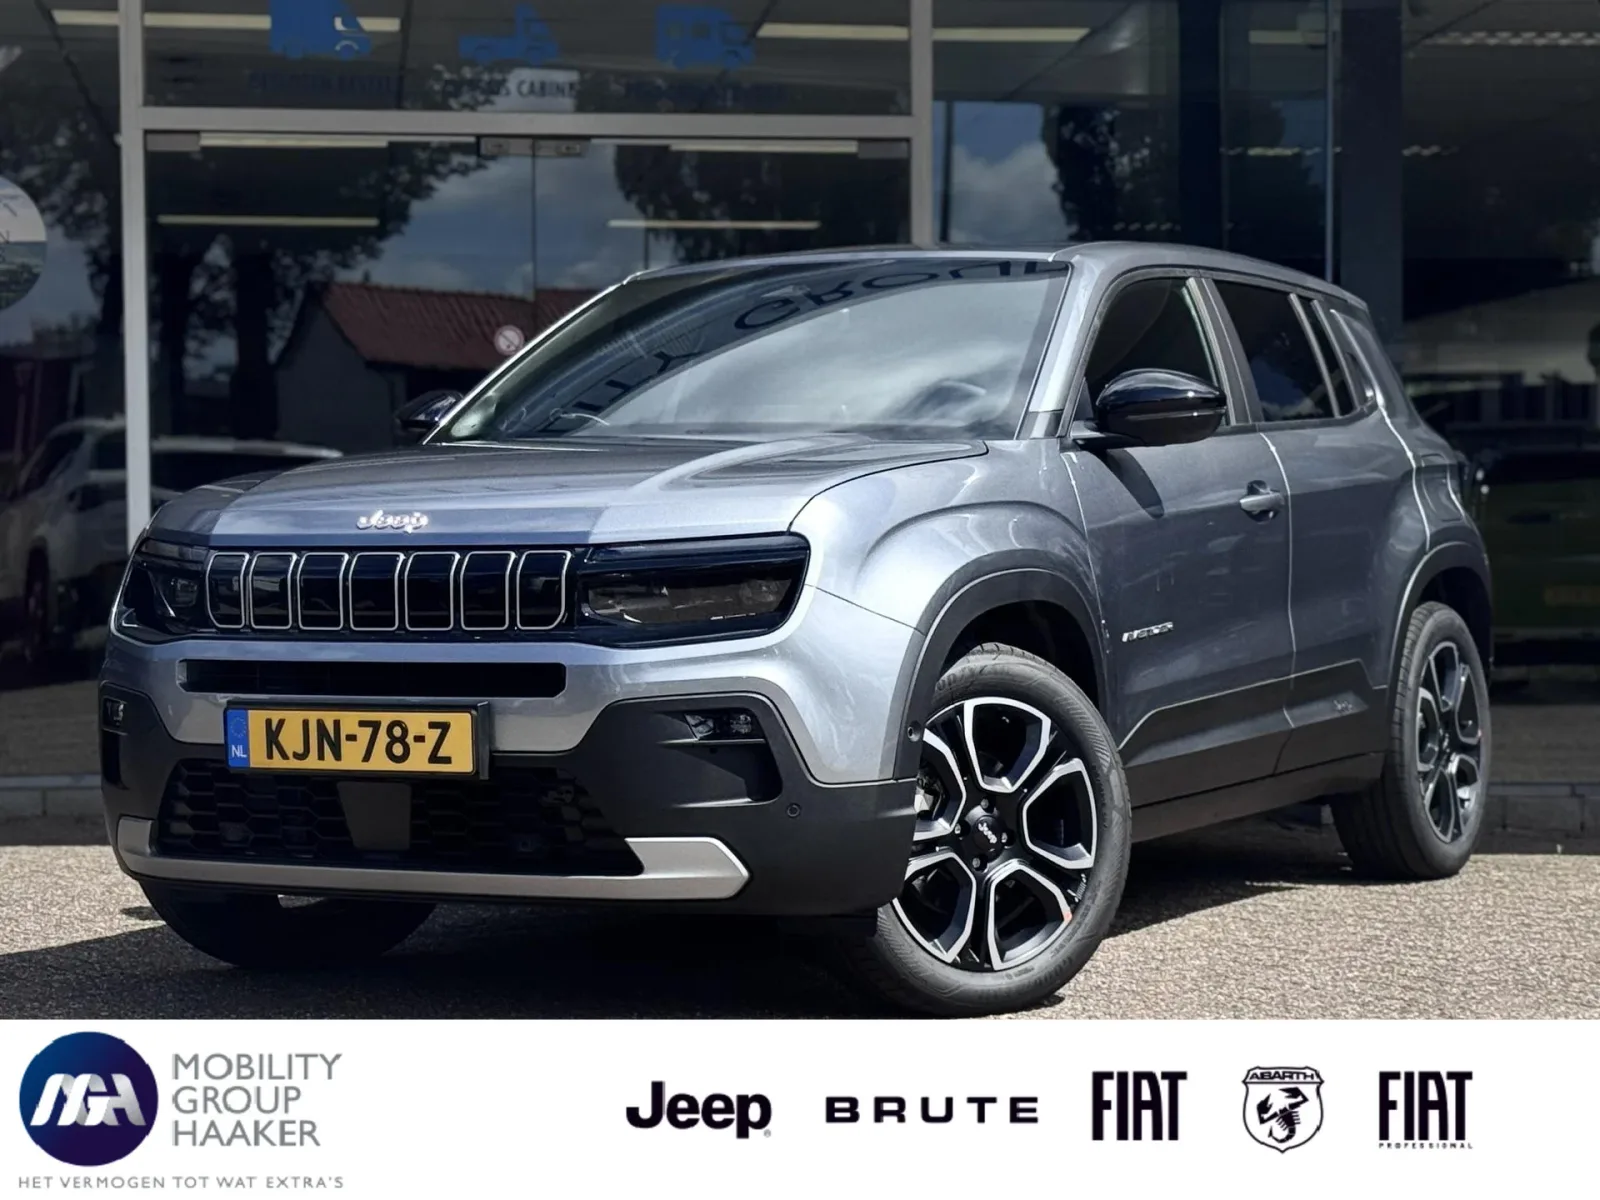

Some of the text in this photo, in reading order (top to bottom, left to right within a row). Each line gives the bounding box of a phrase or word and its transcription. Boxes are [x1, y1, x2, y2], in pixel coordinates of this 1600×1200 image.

[357, 510, 428, 533] Jeep
[231, 744, 247, 758] NL
[264, 718, 452, 765] KJN-78-Z
